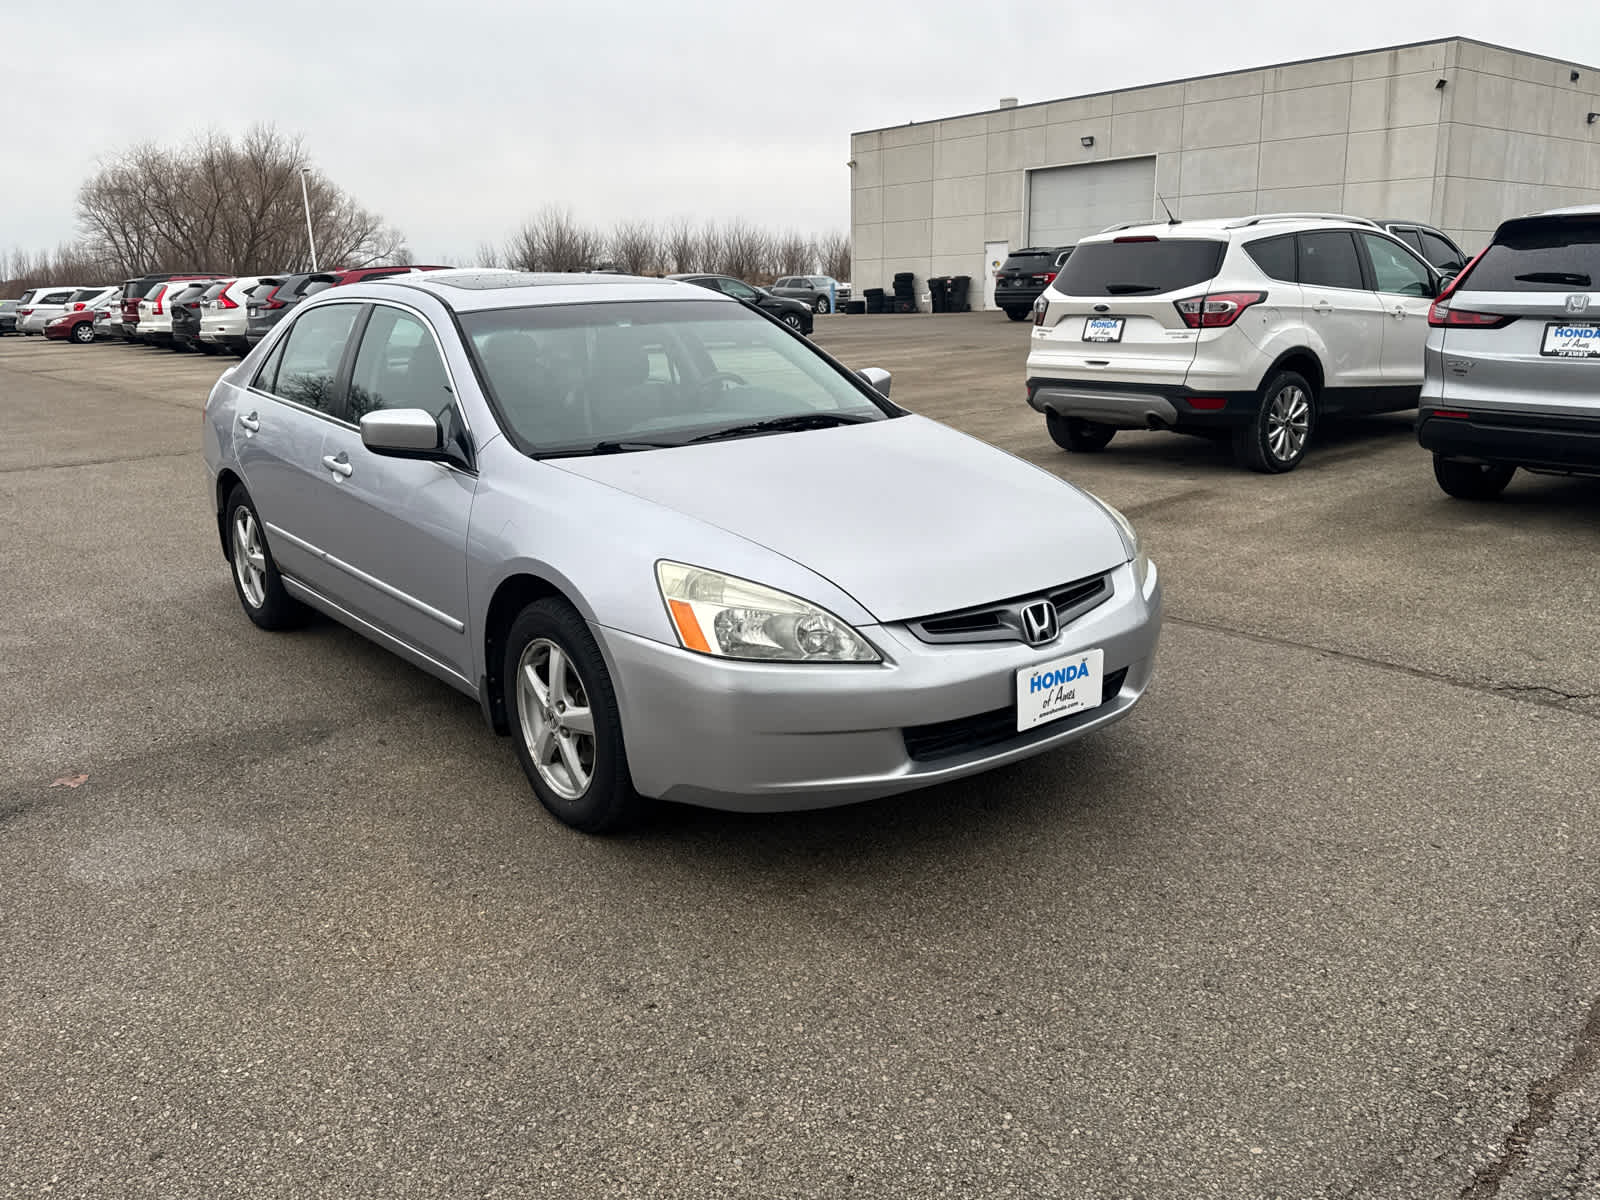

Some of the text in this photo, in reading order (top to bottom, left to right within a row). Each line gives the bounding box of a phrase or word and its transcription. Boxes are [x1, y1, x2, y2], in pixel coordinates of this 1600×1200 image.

[1090, 320, 1118, 329] HONDA
[1554, 328, 1600, 338] HONDA
[1030, 662, 1089, 693] HONDA
[1043, 686, 1076, 708] of Ames
